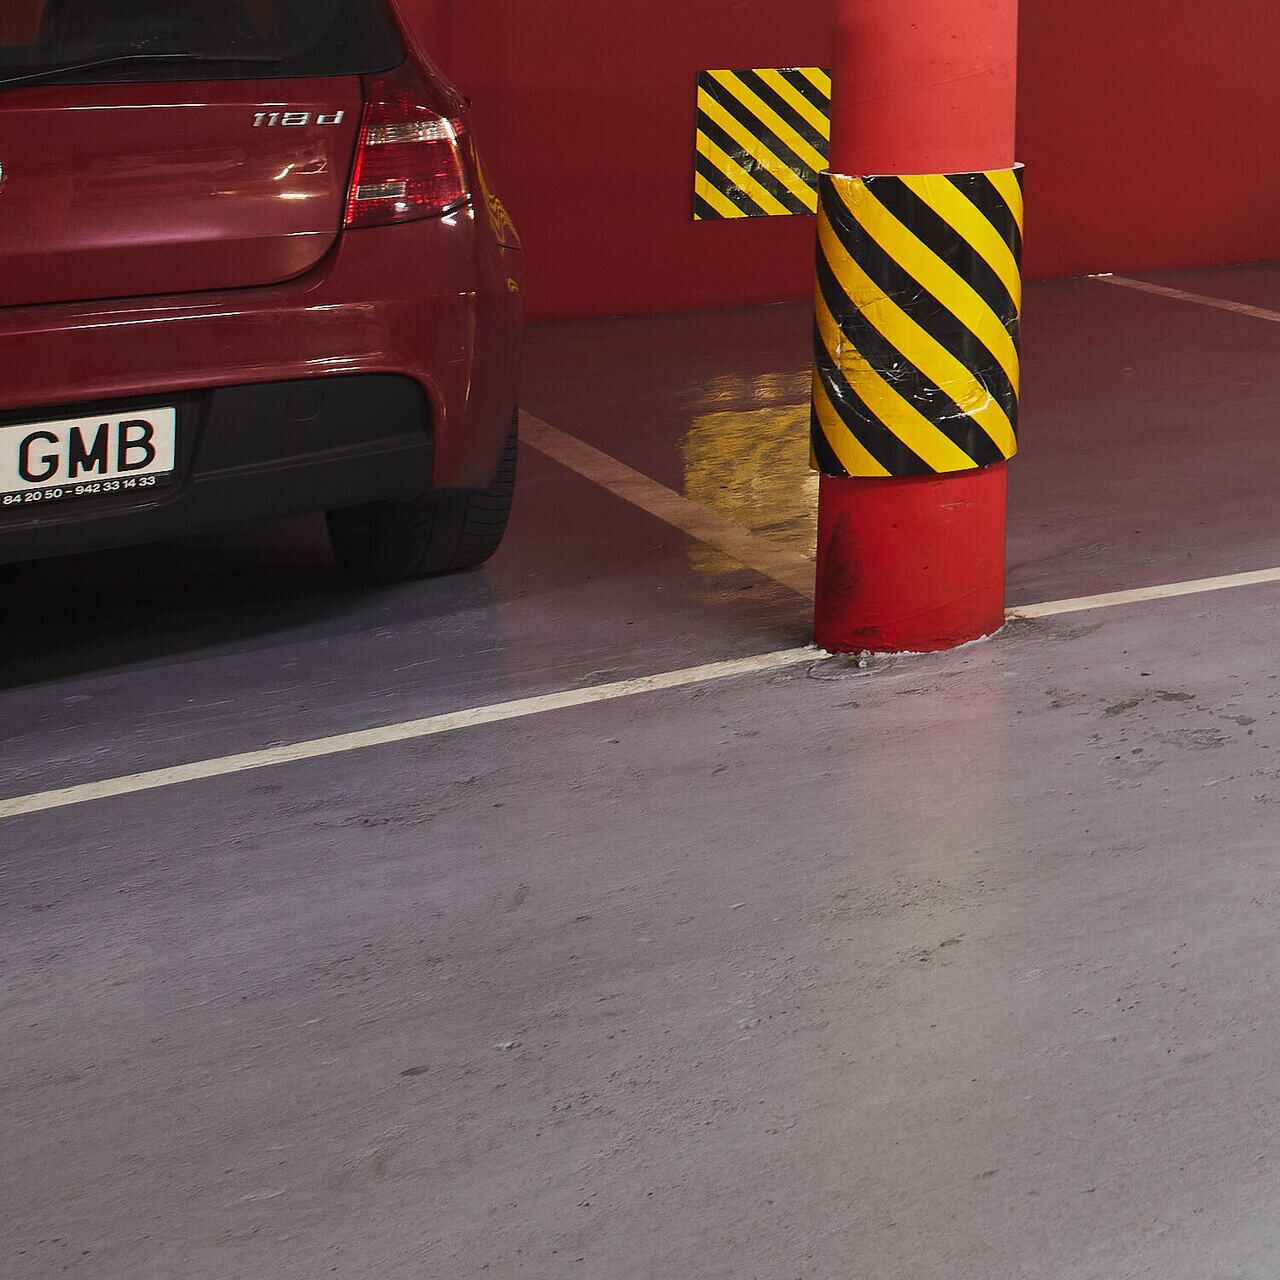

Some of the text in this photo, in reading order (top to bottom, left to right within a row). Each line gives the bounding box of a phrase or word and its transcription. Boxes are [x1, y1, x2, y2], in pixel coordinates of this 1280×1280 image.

[19, 419, 156, 482] GMB
[3, 494, 22, 505] 84
[24, 491, 42, 503] 20
[44, 488, 63, 499] 50
[74, 483, 101, 495] 942
[102, 480, 120, 491] 33
[122, 478, 136, 488] 14
[138, 476, 156, 486] 33
